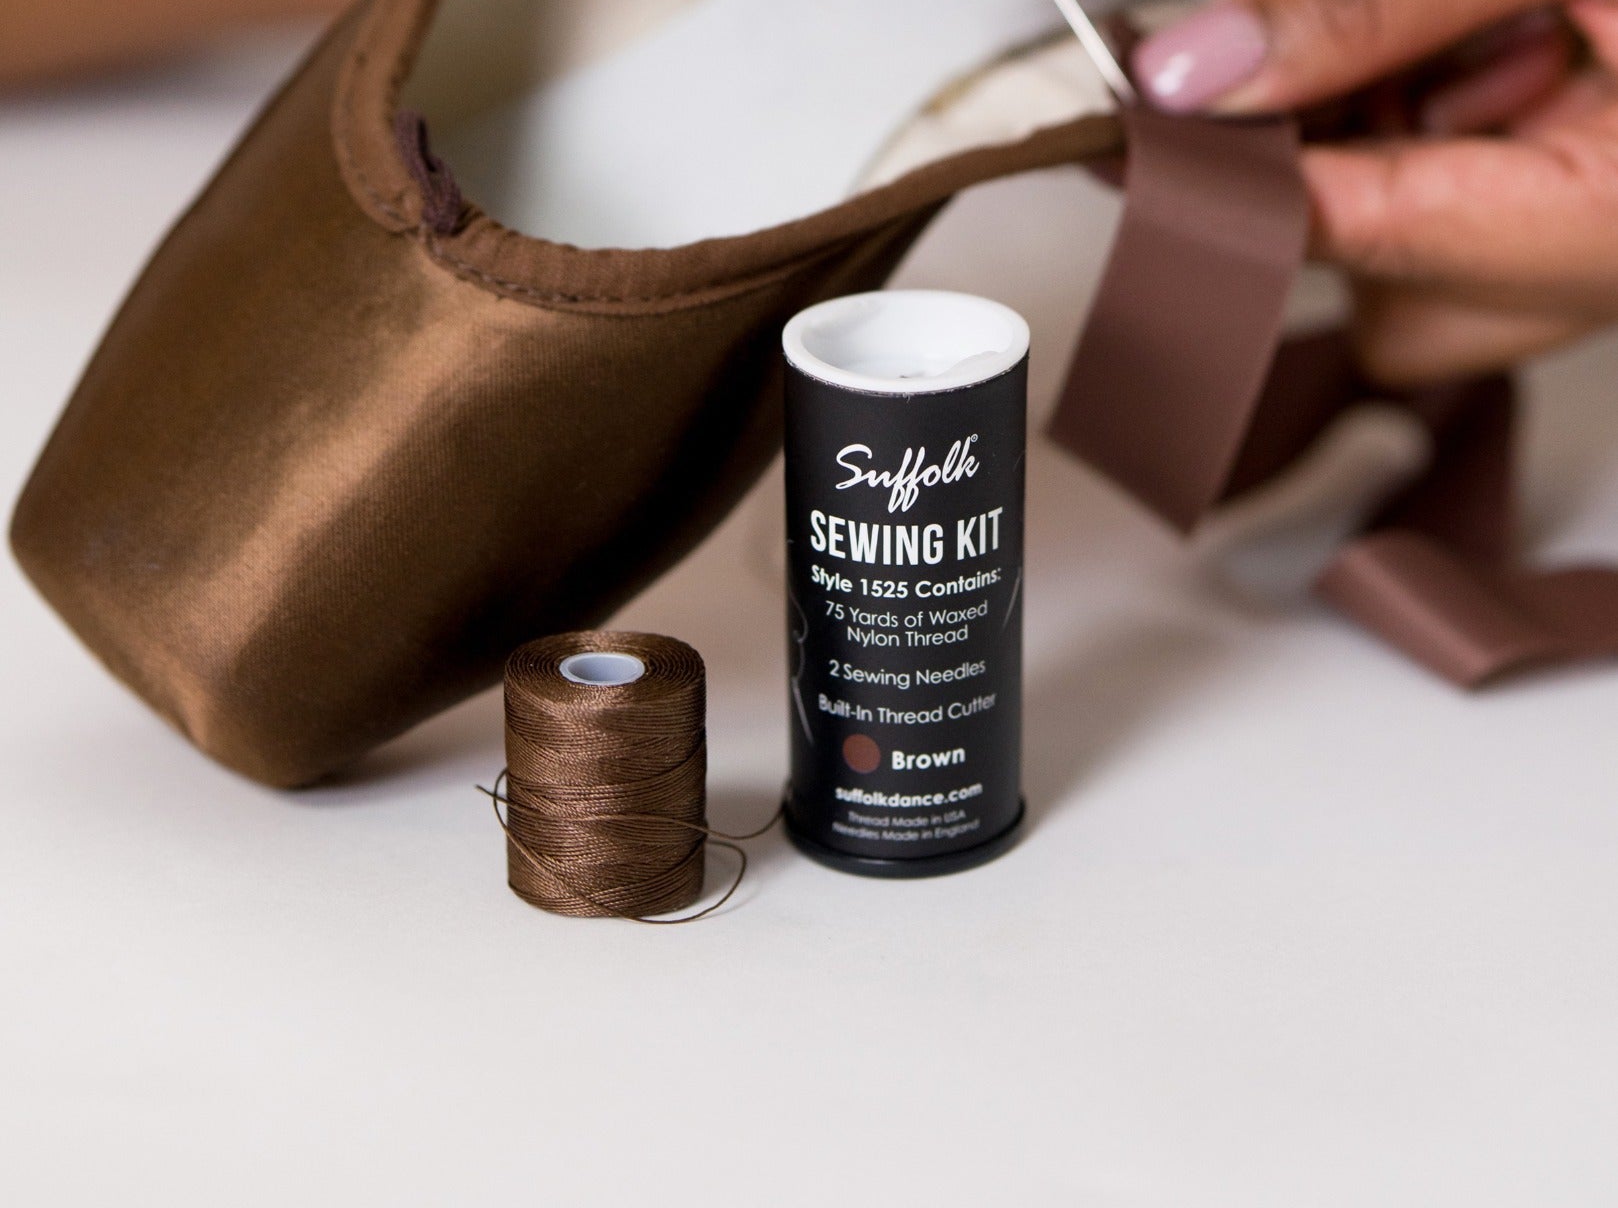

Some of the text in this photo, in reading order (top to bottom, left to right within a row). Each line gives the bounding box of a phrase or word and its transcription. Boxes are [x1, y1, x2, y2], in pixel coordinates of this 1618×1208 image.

[810, 506, 1003, 566] SEWING KIT
[811, 565, 1001, 599] Style 1525 Contains:
[825, 600, 988, 627] 75 Yards of Waxed
[847, 625, 969, 648] Nylon Thread
[829, 660, 986, 690] 2 Sewing Needles
[818, 692, 997, 725] Built-In Thread Cutter
[892, 747, 966, 770] Brown
[835, 782, 983, 809] suffolkdance.com
[832, 819, 980, 841] Needles Made in England
[848, 810, 966, 828] Thread Made in USA
